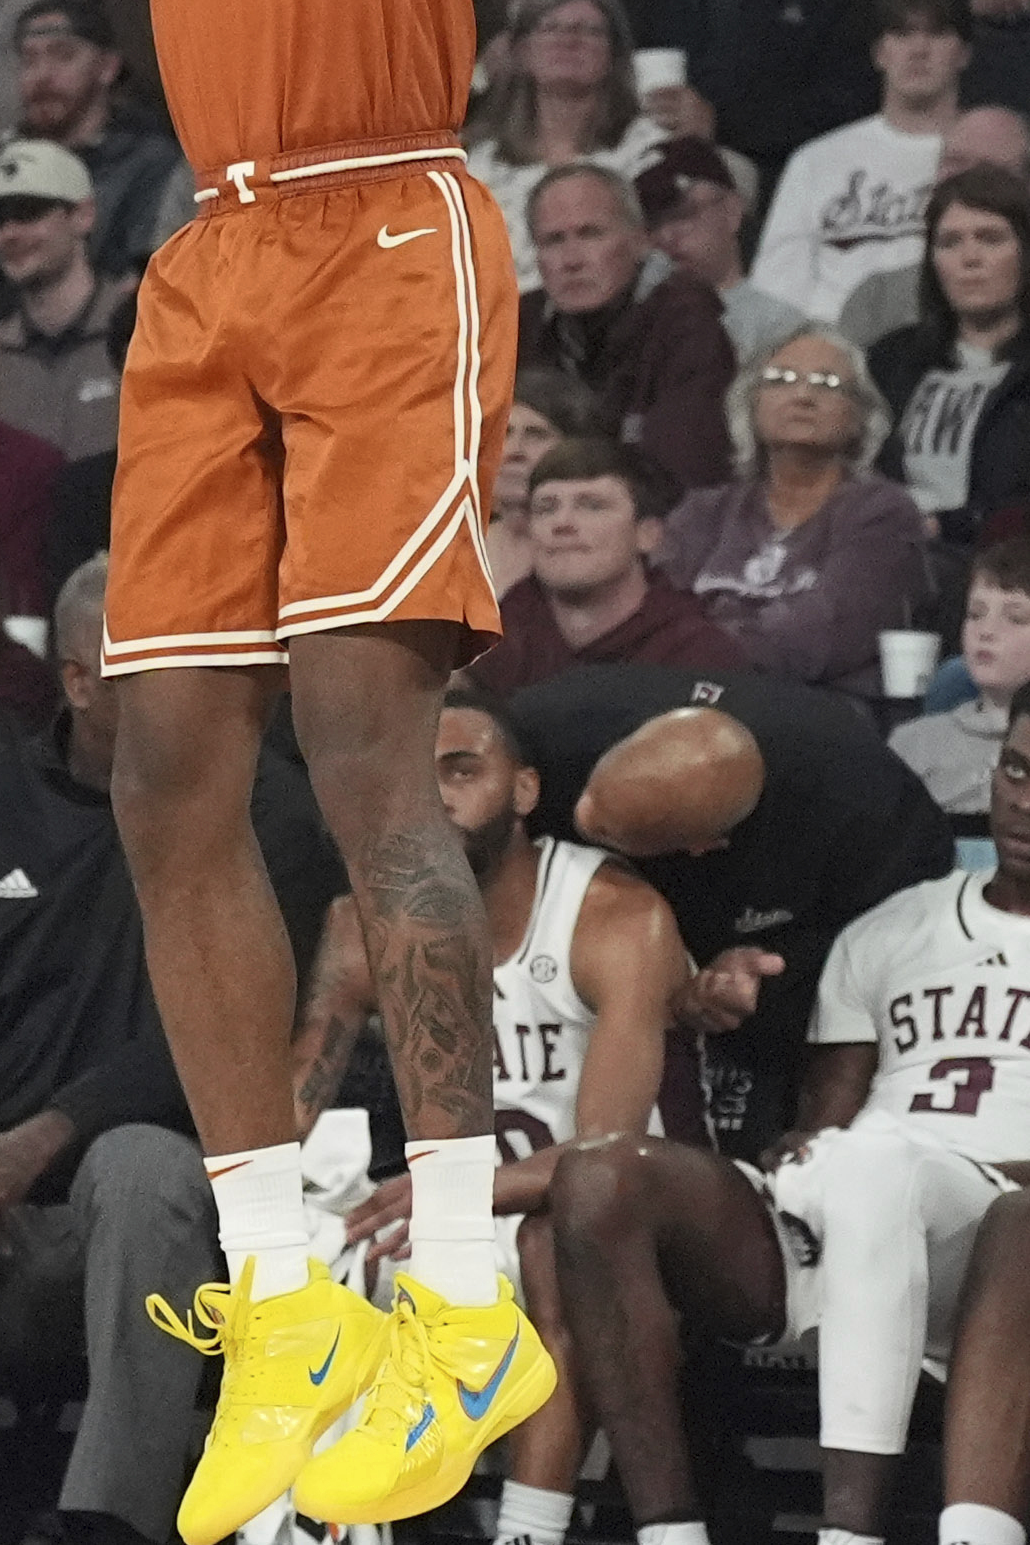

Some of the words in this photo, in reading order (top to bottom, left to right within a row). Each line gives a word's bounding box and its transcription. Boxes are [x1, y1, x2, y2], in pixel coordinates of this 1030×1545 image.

[226, 160, 257, 204] T
[889, 984, 1030, 1055] STAT
[908, 1055, 996, 1117] 3
